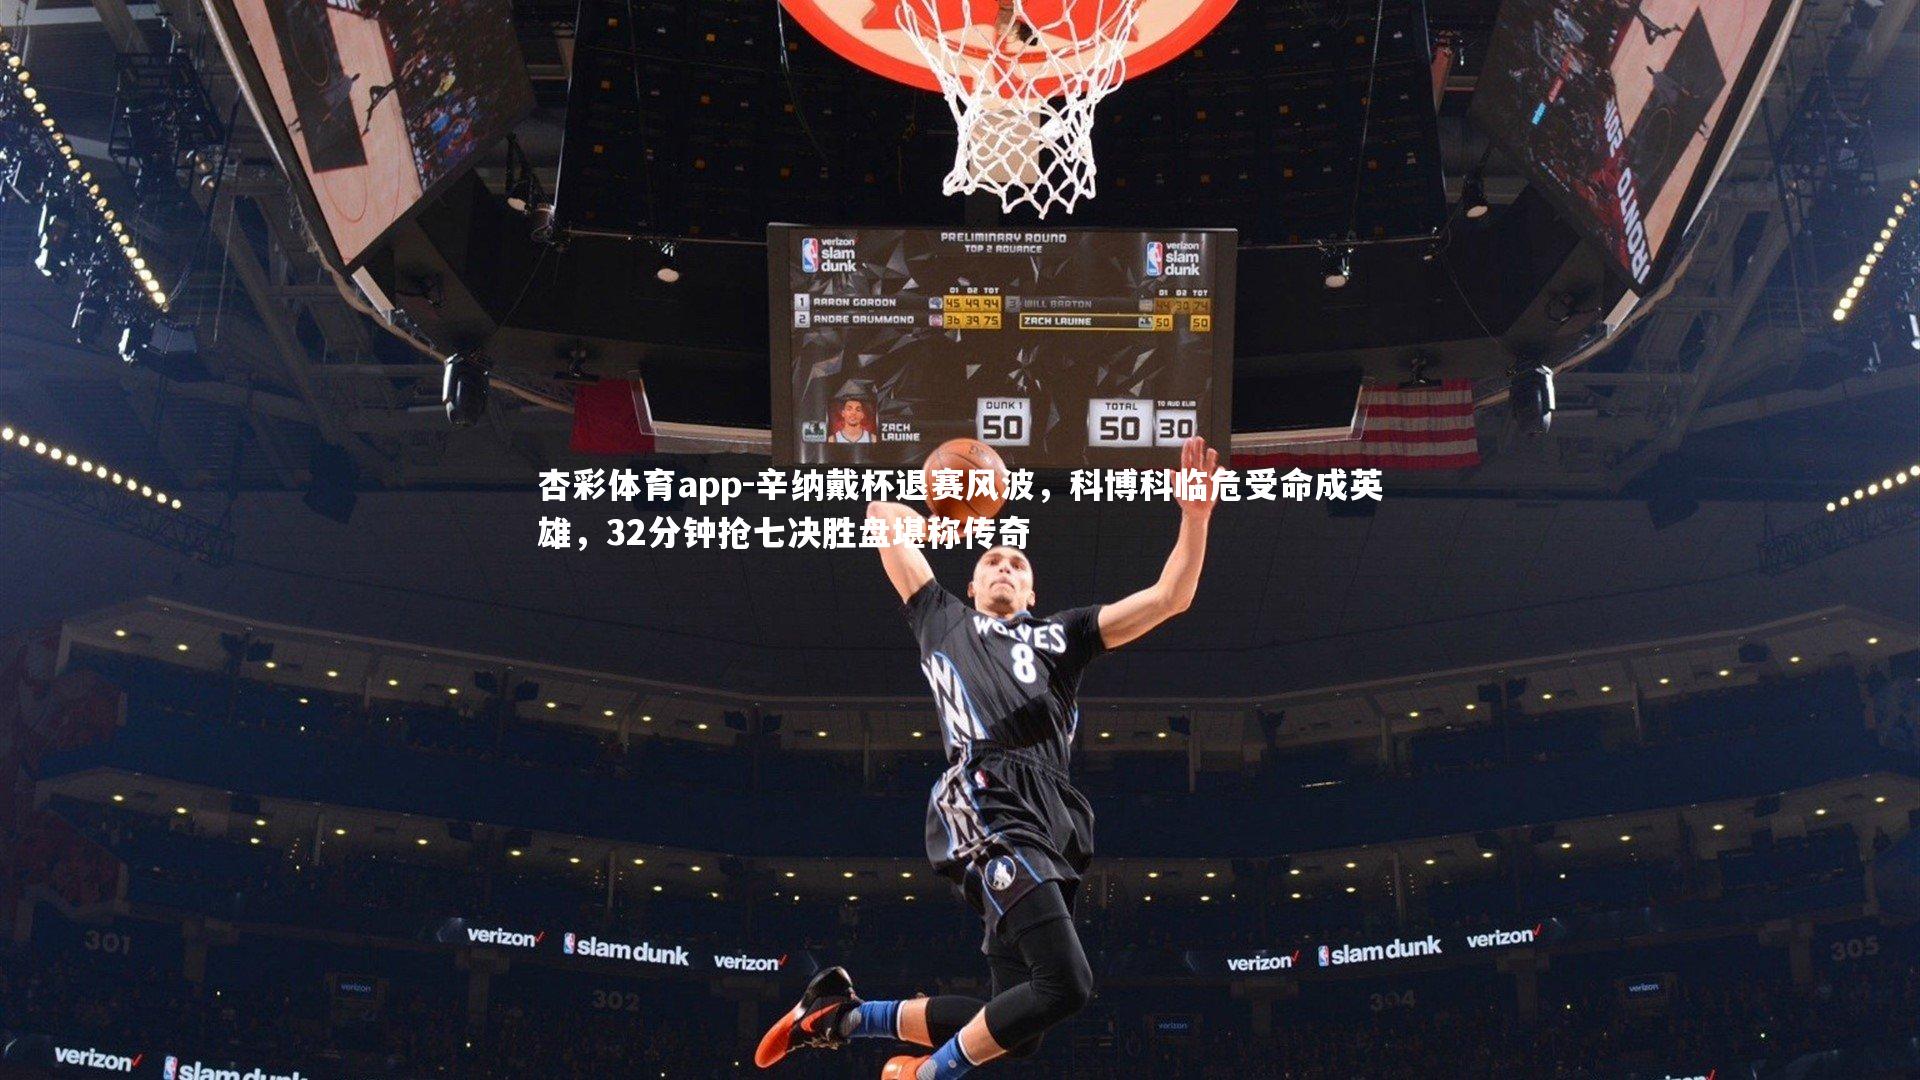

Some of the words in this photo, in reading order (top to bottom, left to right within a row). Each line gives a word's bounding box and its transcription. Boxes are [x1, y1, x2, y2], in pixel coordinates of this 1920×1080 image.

[821, 237, 855, 246] verizon
[940, 232, 1021, 242] PRELIMINARY
[1025, 233, 1067, 243] ROUND
[964, 244, 984, 253] TOP
[1165, 240, 1200, 250] verizon
[821, 246, 856, 259] slam
[1165, 250, 1200, 263] slam
[821, 260, 857, 272] dunk
[1164, 263, 1200, 276] dunk
[813, 298, 850, 307] AARON
[853, 298, 897, 307] GORDON
[946, 299, 960, 308] 45
[965, 299, 980, 308] 49
[983, 299, 999, 308] 94
[813, 315, 850, 324] ANDRE
[965, 316, 980, 325] 39
[983, 316, 999, 325] 75
[1024, 316, 1052, 325] ZACH
[1156, 317, 1170, 327] 50
[1193, 318, 1208, 327] 50
[986, 401, 1015, 410] DUNK
[1105, 402, 1138, 411] TOTAL
[881, 423, 911, 432] ZACH
[983, 415, 1023, 440] 50
[1100, 416, 1141, 441] 50
[1159, 418, 1193, 438] 30
[1011, 642, 1037, 684] 8
[467, 927, 536, 948] verizon
[1467, 928, 1534, 949] verizon
[577, 937, 631, 960] slam
[633, 943, 689, 967] dunk
[1332, 944, 1384, 966] slam
[1386, 935, 1442, 959] dunk
[714, 953, 779, 972] verizon
[1227, 953, 1292, 972] verizon
[340, 982, 372, 994] verizon
[1629, 981, 1660, 993] verizon
[1158, 1020, 1188, 1031] verizon
[55, 1046, 132, 1072] verizon
